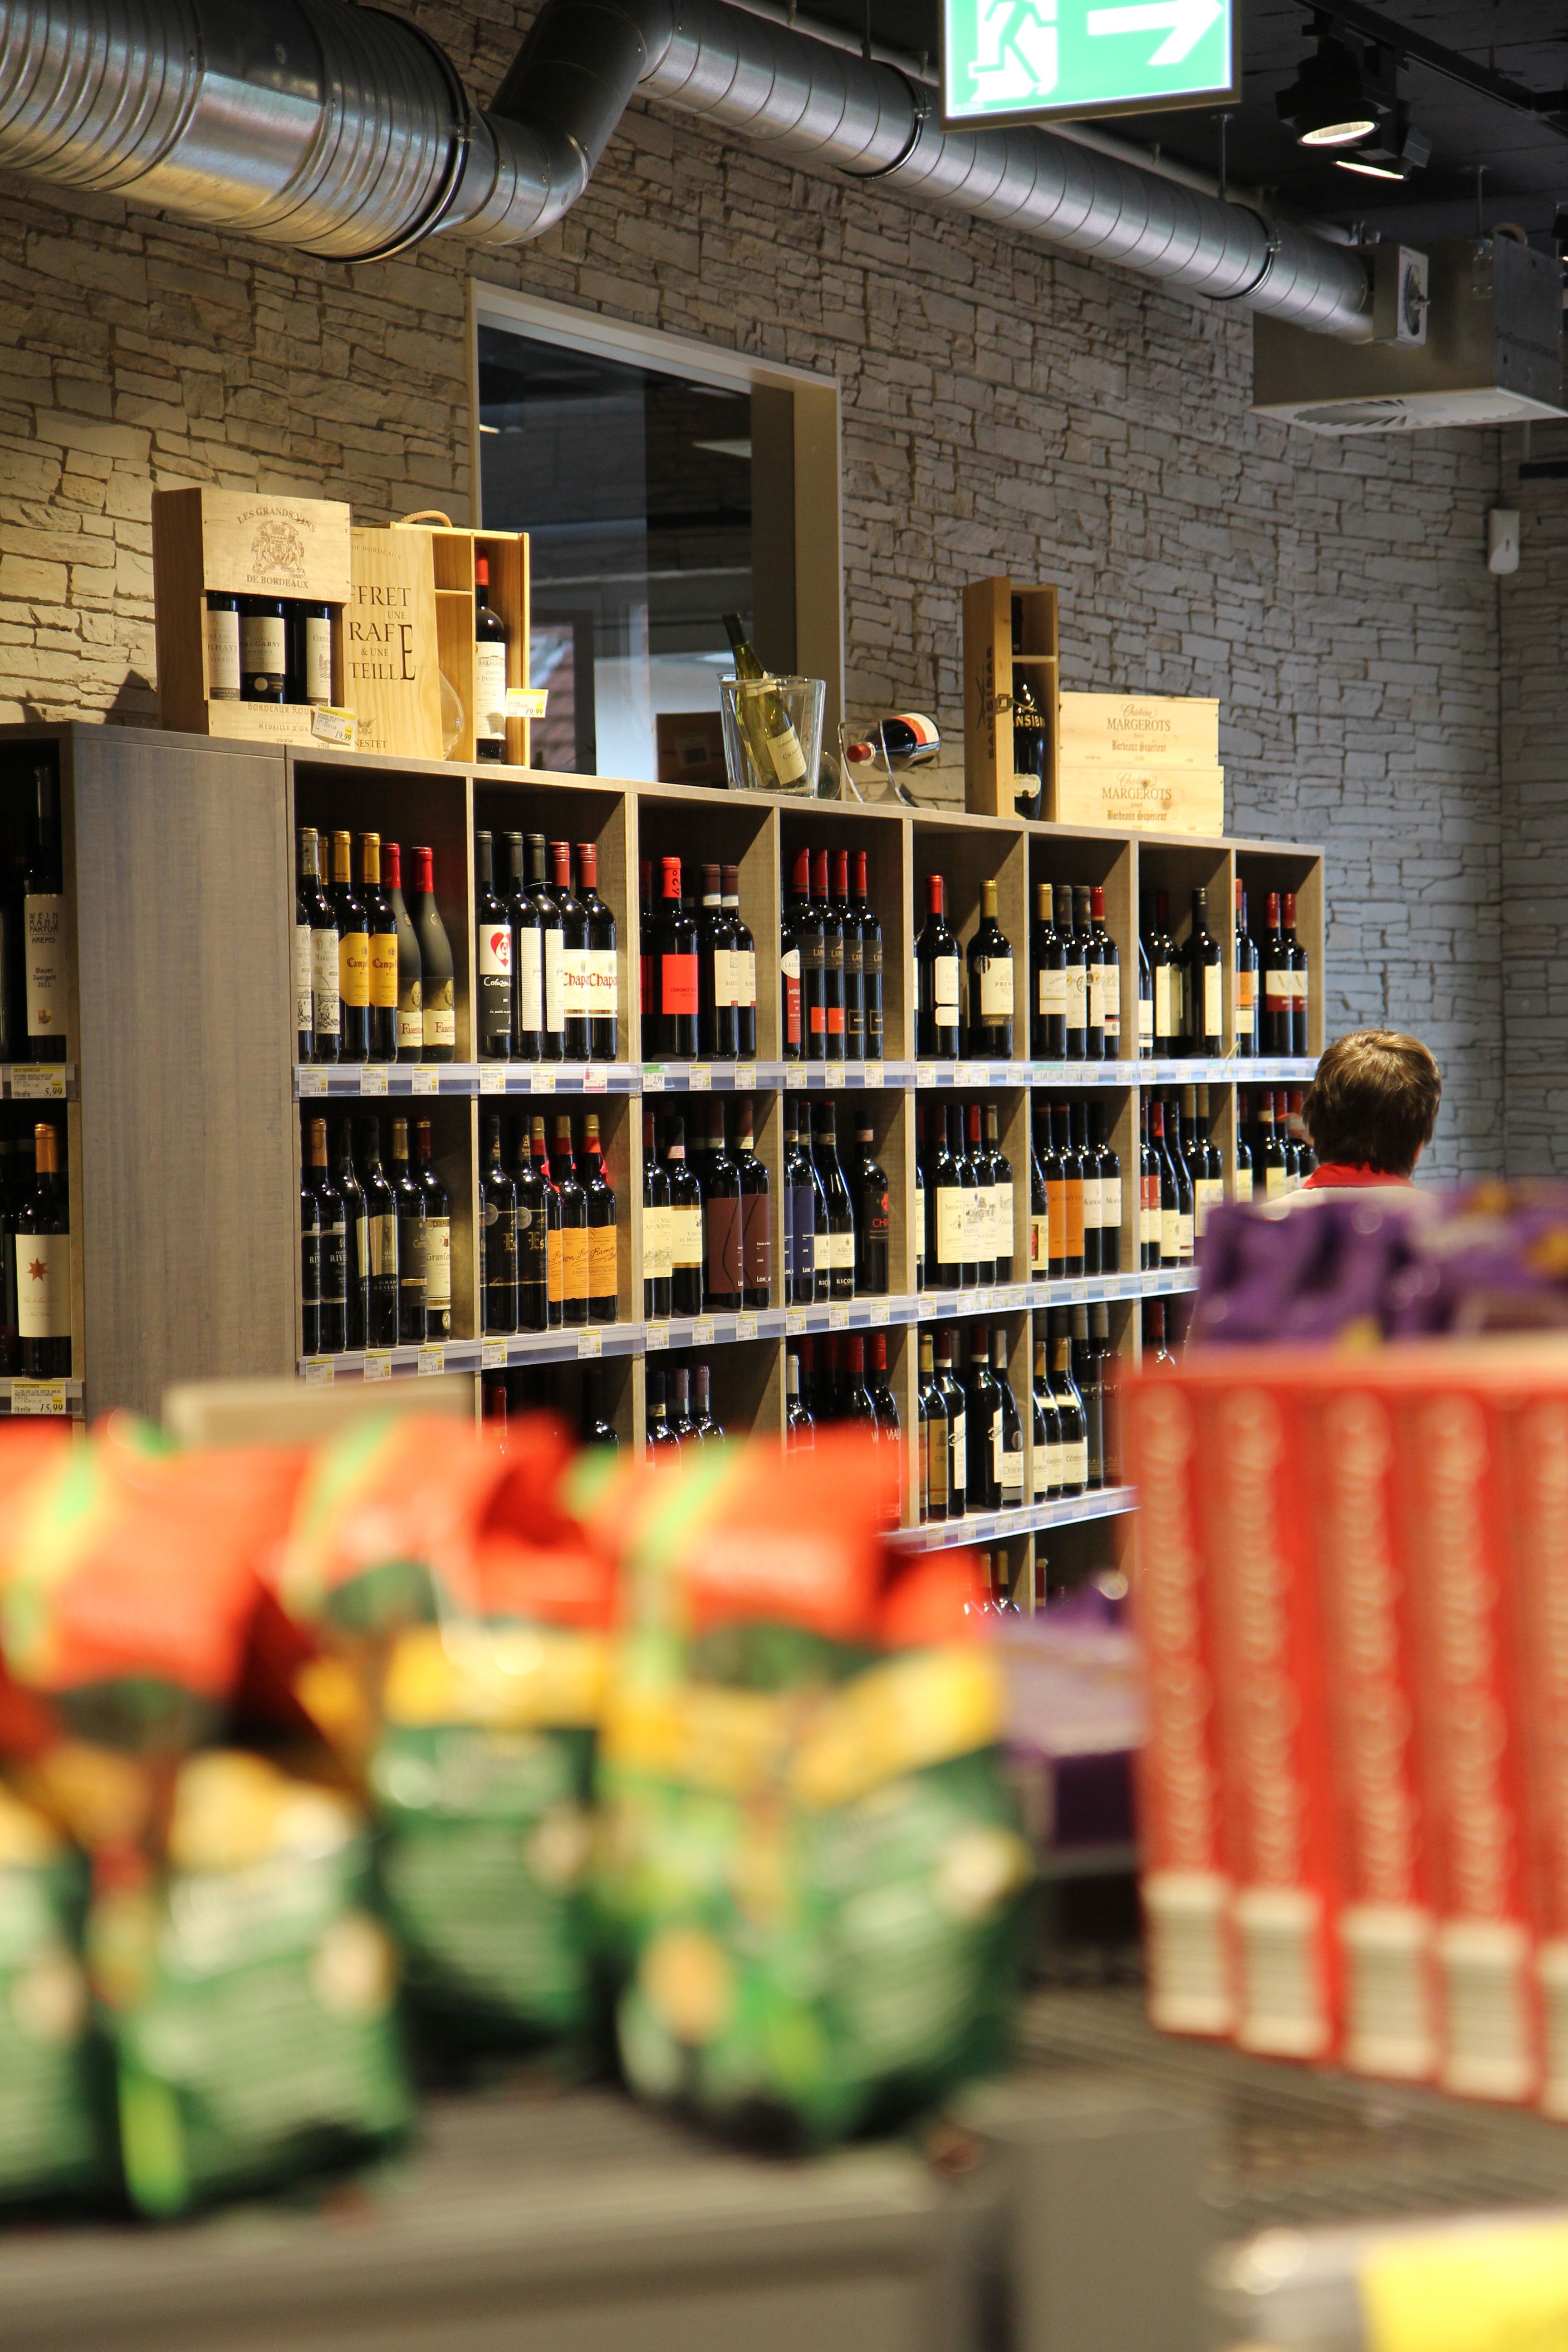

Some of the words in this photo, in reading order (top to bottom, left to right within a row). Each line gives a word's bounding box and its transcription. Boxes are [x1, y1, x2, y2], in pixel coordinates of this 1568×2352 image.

[237, 510, 254, 524] LES
[256, 507, 293, 519] GRANDS
[294, 514, 316, 533] VINS
[363, 545, 402, 560] BORDEAUX
[246, 574, 259, 583] DE
[261, 576, 309, 589] BORDEAUX
[387, 611, 406, 620] UNE
[370, 648, 389, 657] UNE
[248, 702, 289, 714] BORDEAUX
[525, 707, 544, 716] 19,99
[1107, 717, 1171, 731] MARGEROTS
[334, 730, 352, 742] 19,99
[1102, 787, 1171, 800] MARGEROTS
[29, 926, 59, 934] FAKTUR
[653, 1075, 663, 1085] 2,99
[45, 1087, 63, 1097] 5,99
[40, 1403, 63, 1412] 15,99
